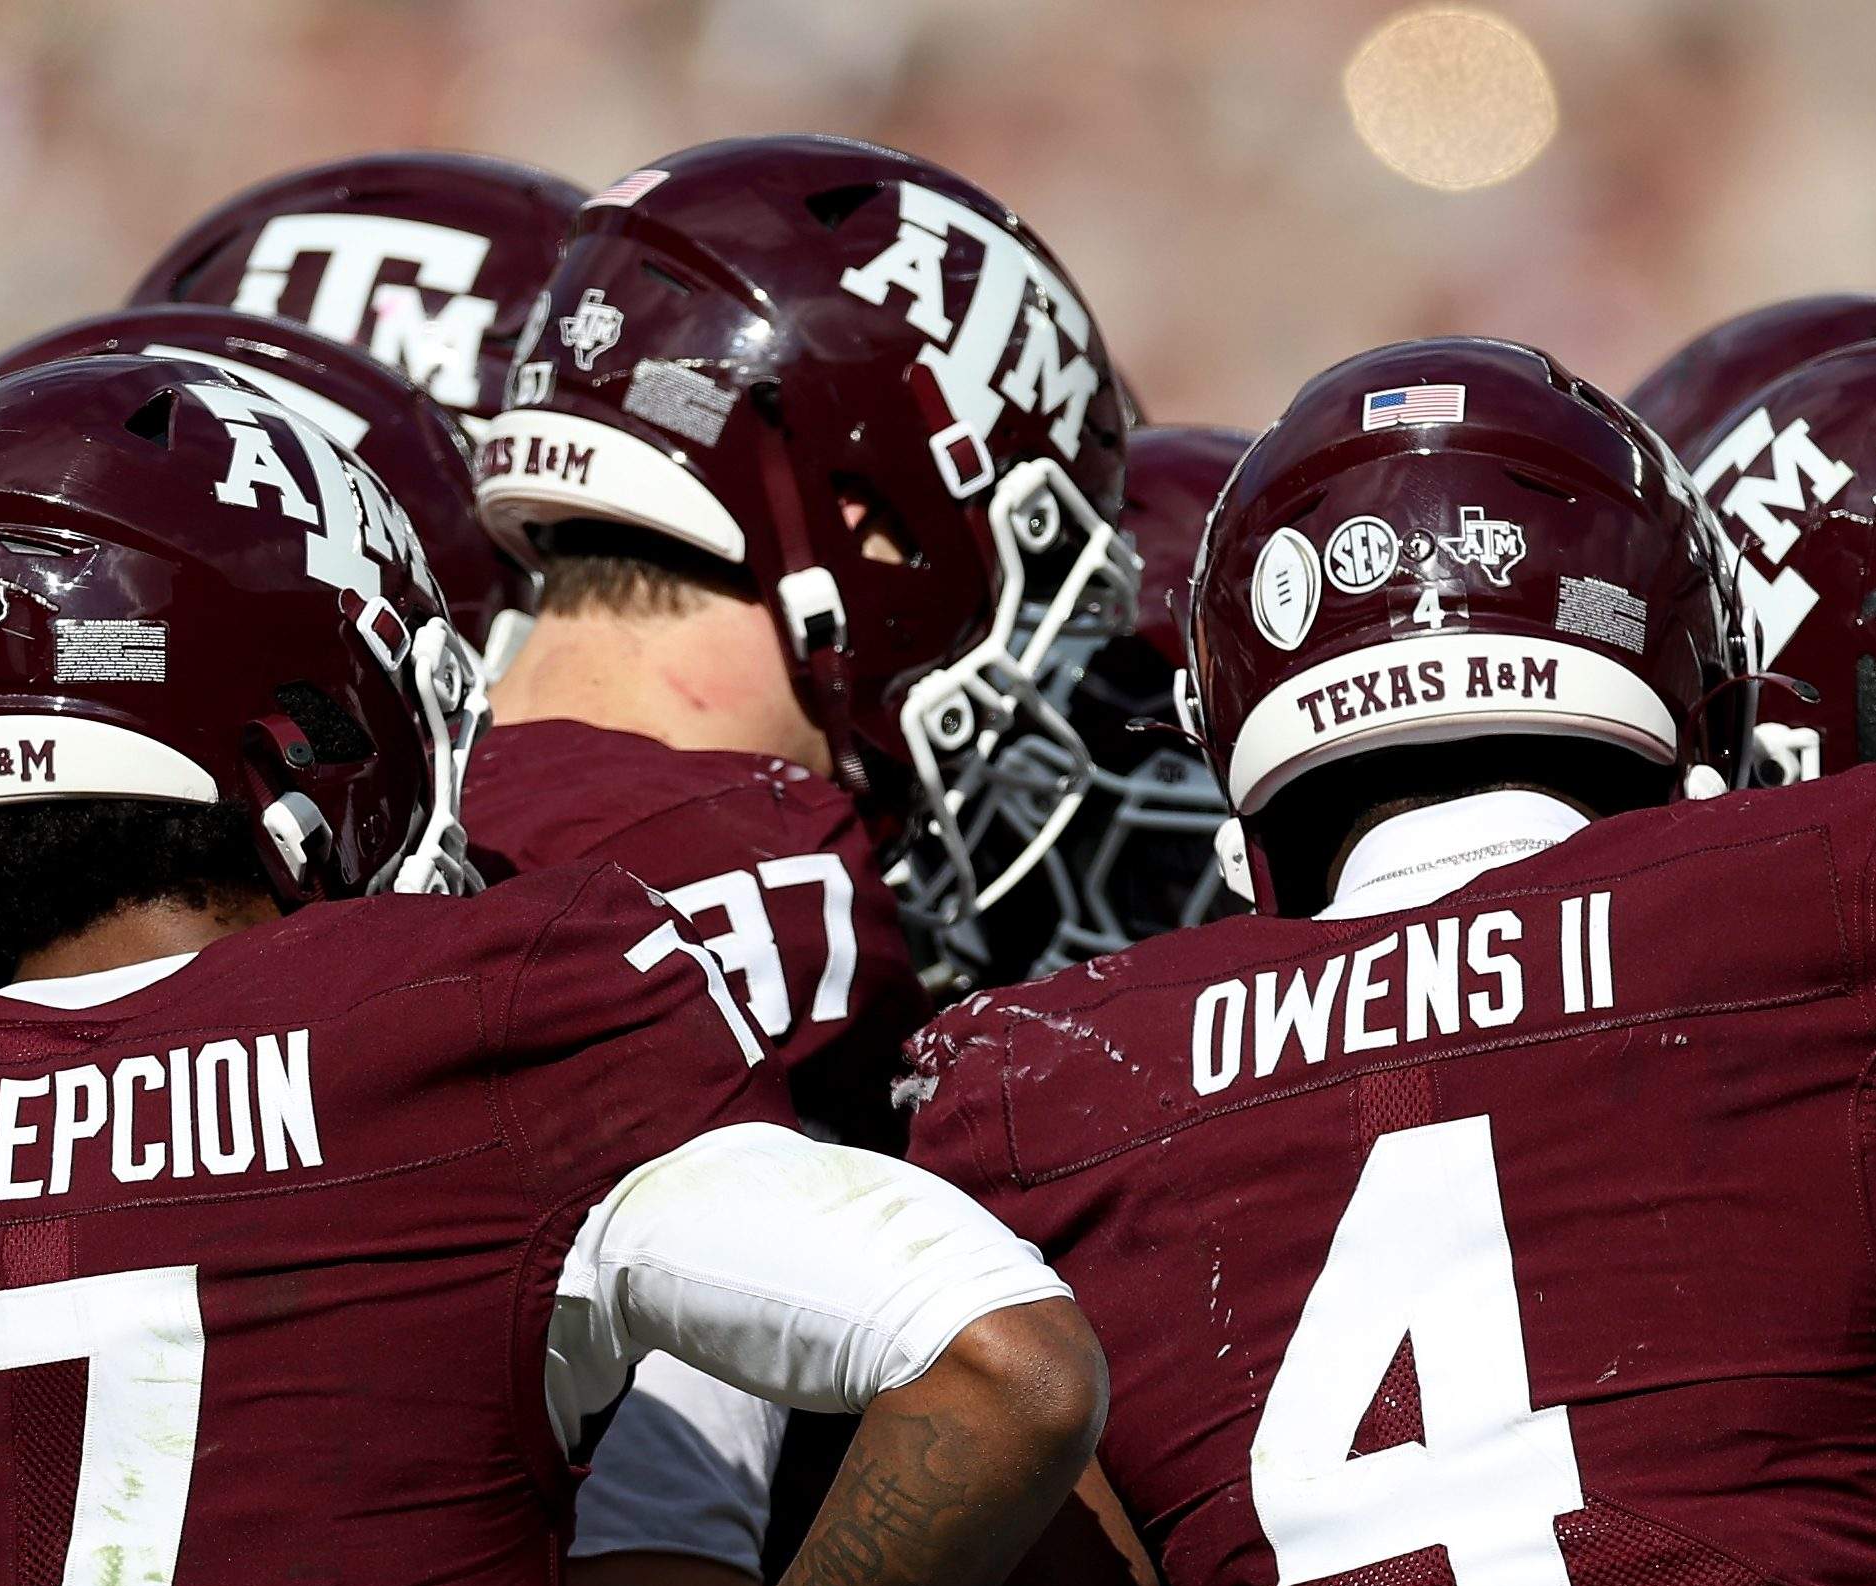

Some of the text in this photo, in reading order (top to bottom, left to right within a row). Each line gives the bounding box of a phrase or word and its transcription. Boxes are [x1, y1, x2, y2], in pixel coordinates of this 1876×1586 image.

[1332, 524, 1392, 584] SEC
[1412, 588, 1445, 629] 4
[1298, 656, 1558, 733] TEXAS A&M
[1190, 891, 1612, 1098] OWENS II
